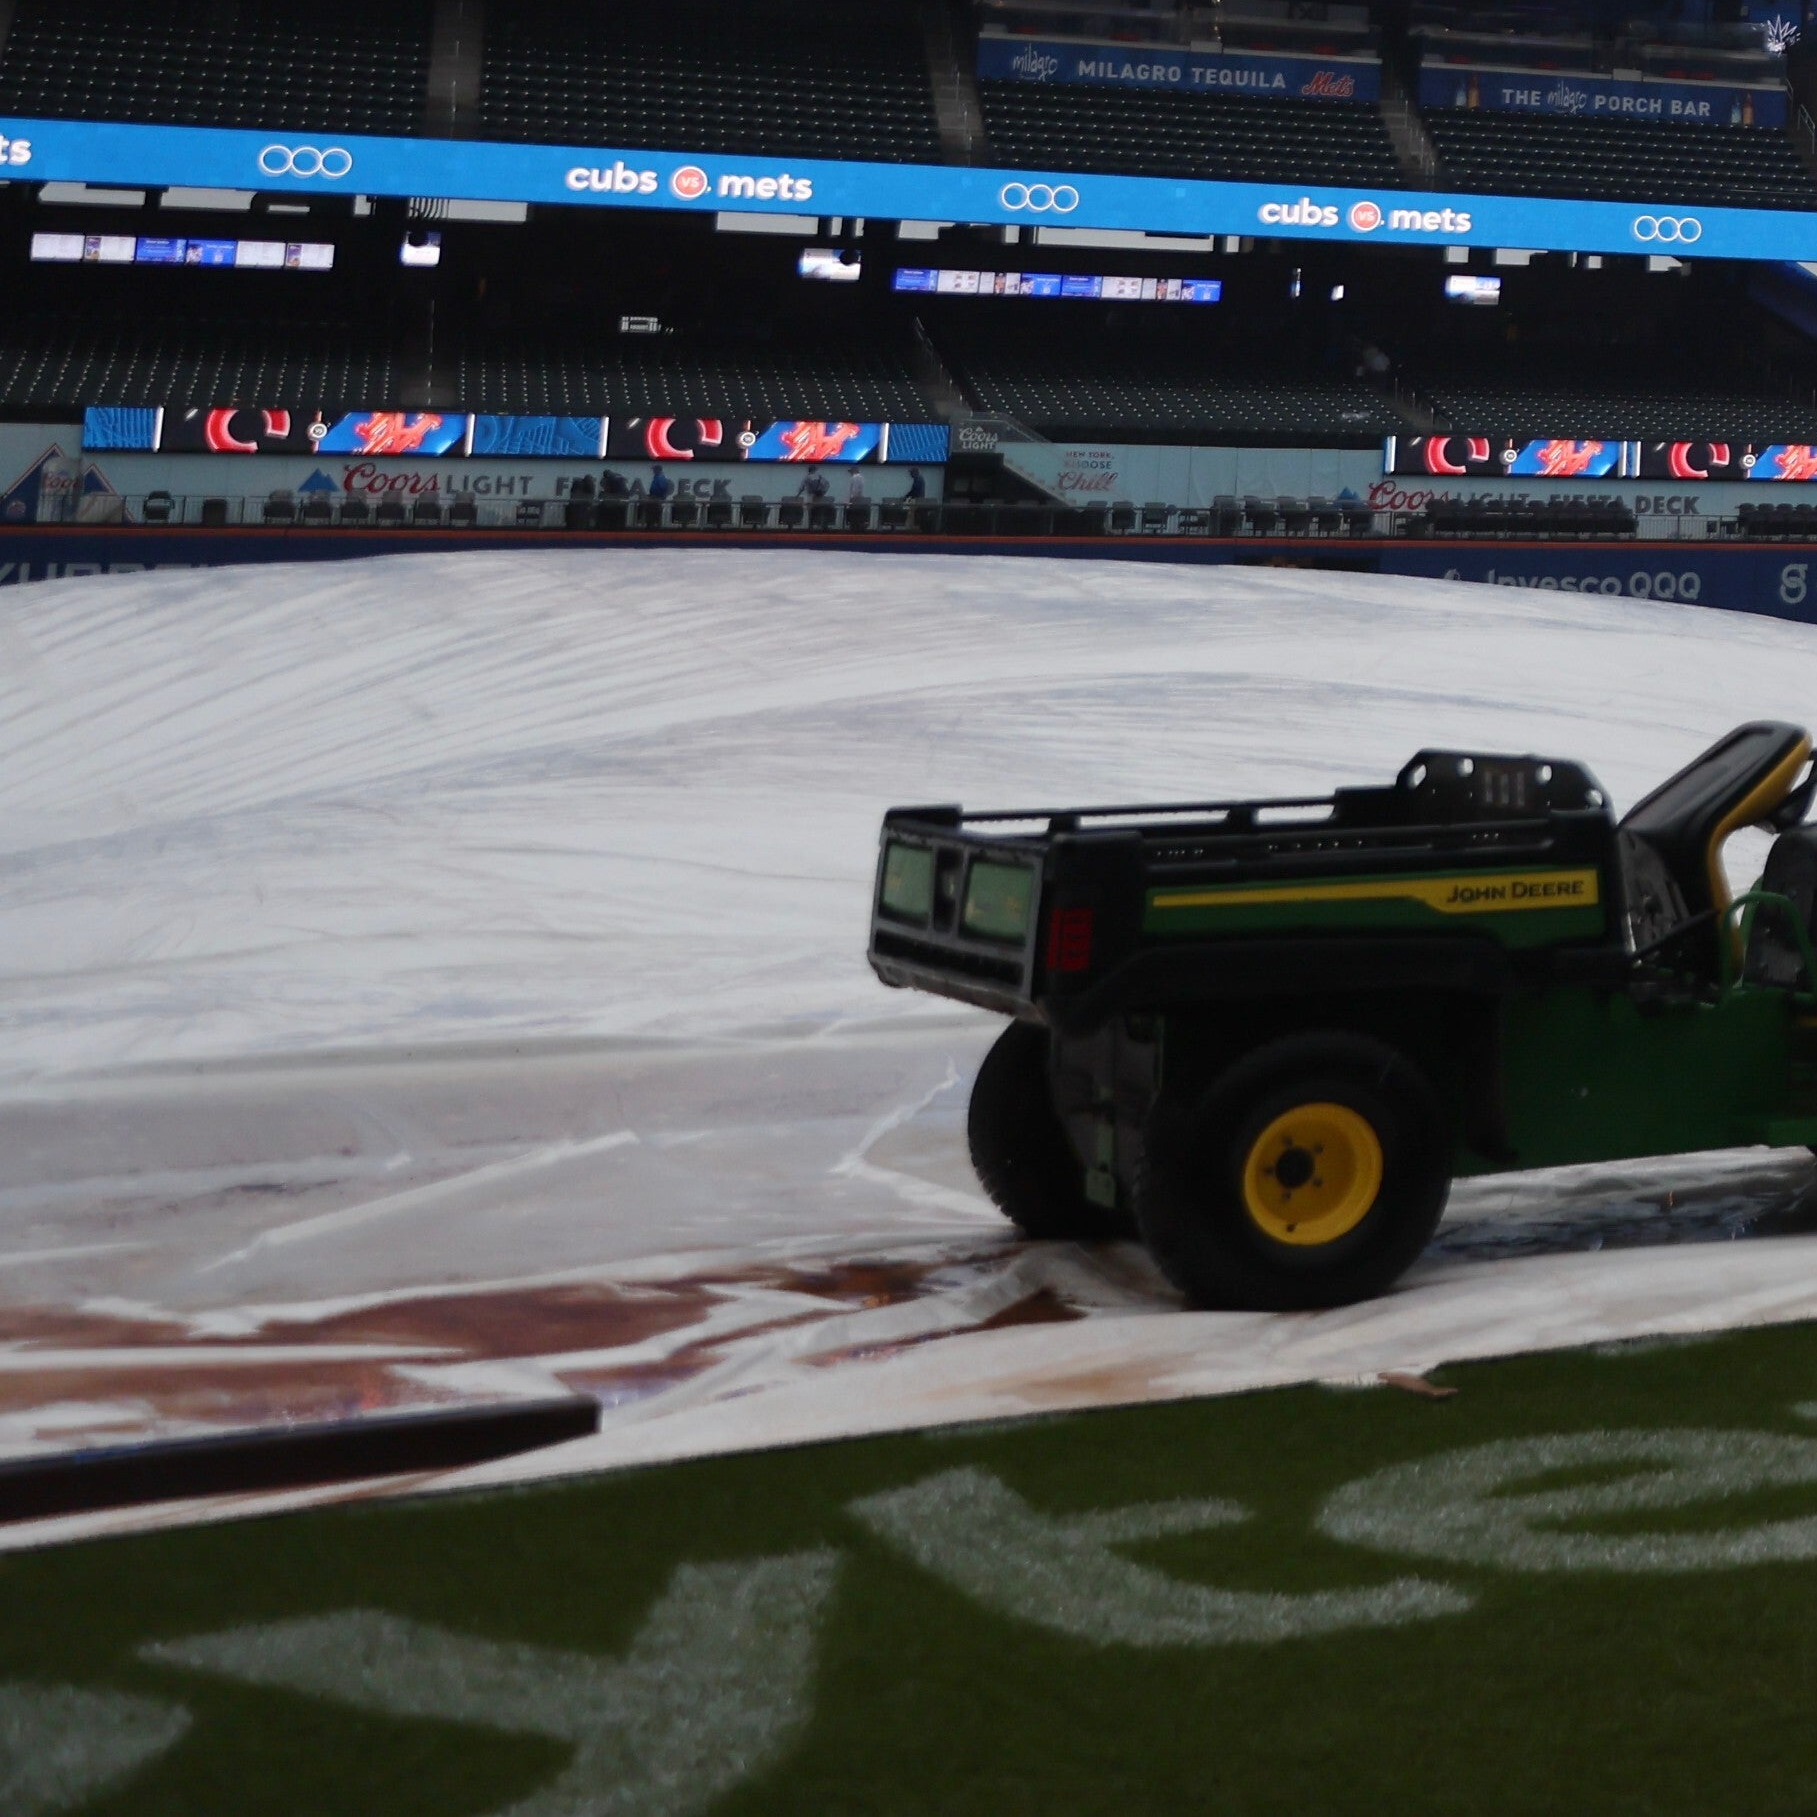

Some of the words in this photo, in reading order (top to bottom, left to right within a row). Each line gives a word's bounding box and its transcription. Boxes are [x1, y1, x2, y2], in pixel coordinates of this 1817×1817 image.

[1078, 58, 1182, 84] MILAGRO
[1191, 64, 1285, 89] TEQUILA
[1301, 71, 1354, 97] Mets
[1502, 88, 1541, 106] THE
[1594, 94, 1665, 114] PORCH
[1671, 99, 1711, 117] BAR
[566, 163, 658, 195] cubs
[719, 174, 813, 202] mets
[1257, 198, 1338, 227] cubs
[1391, 206, 1471, 233] mets
[344, 462, 439, 494] Coors
[447, 475, 533, 496] LIGHT
[1637, 496, 1700, 514] DECK
[1629, 571, 1700, 602] QQQ
[1448, 885, 1505, 903] JOHN
[1512, 880, 1584, 898] DEERE
